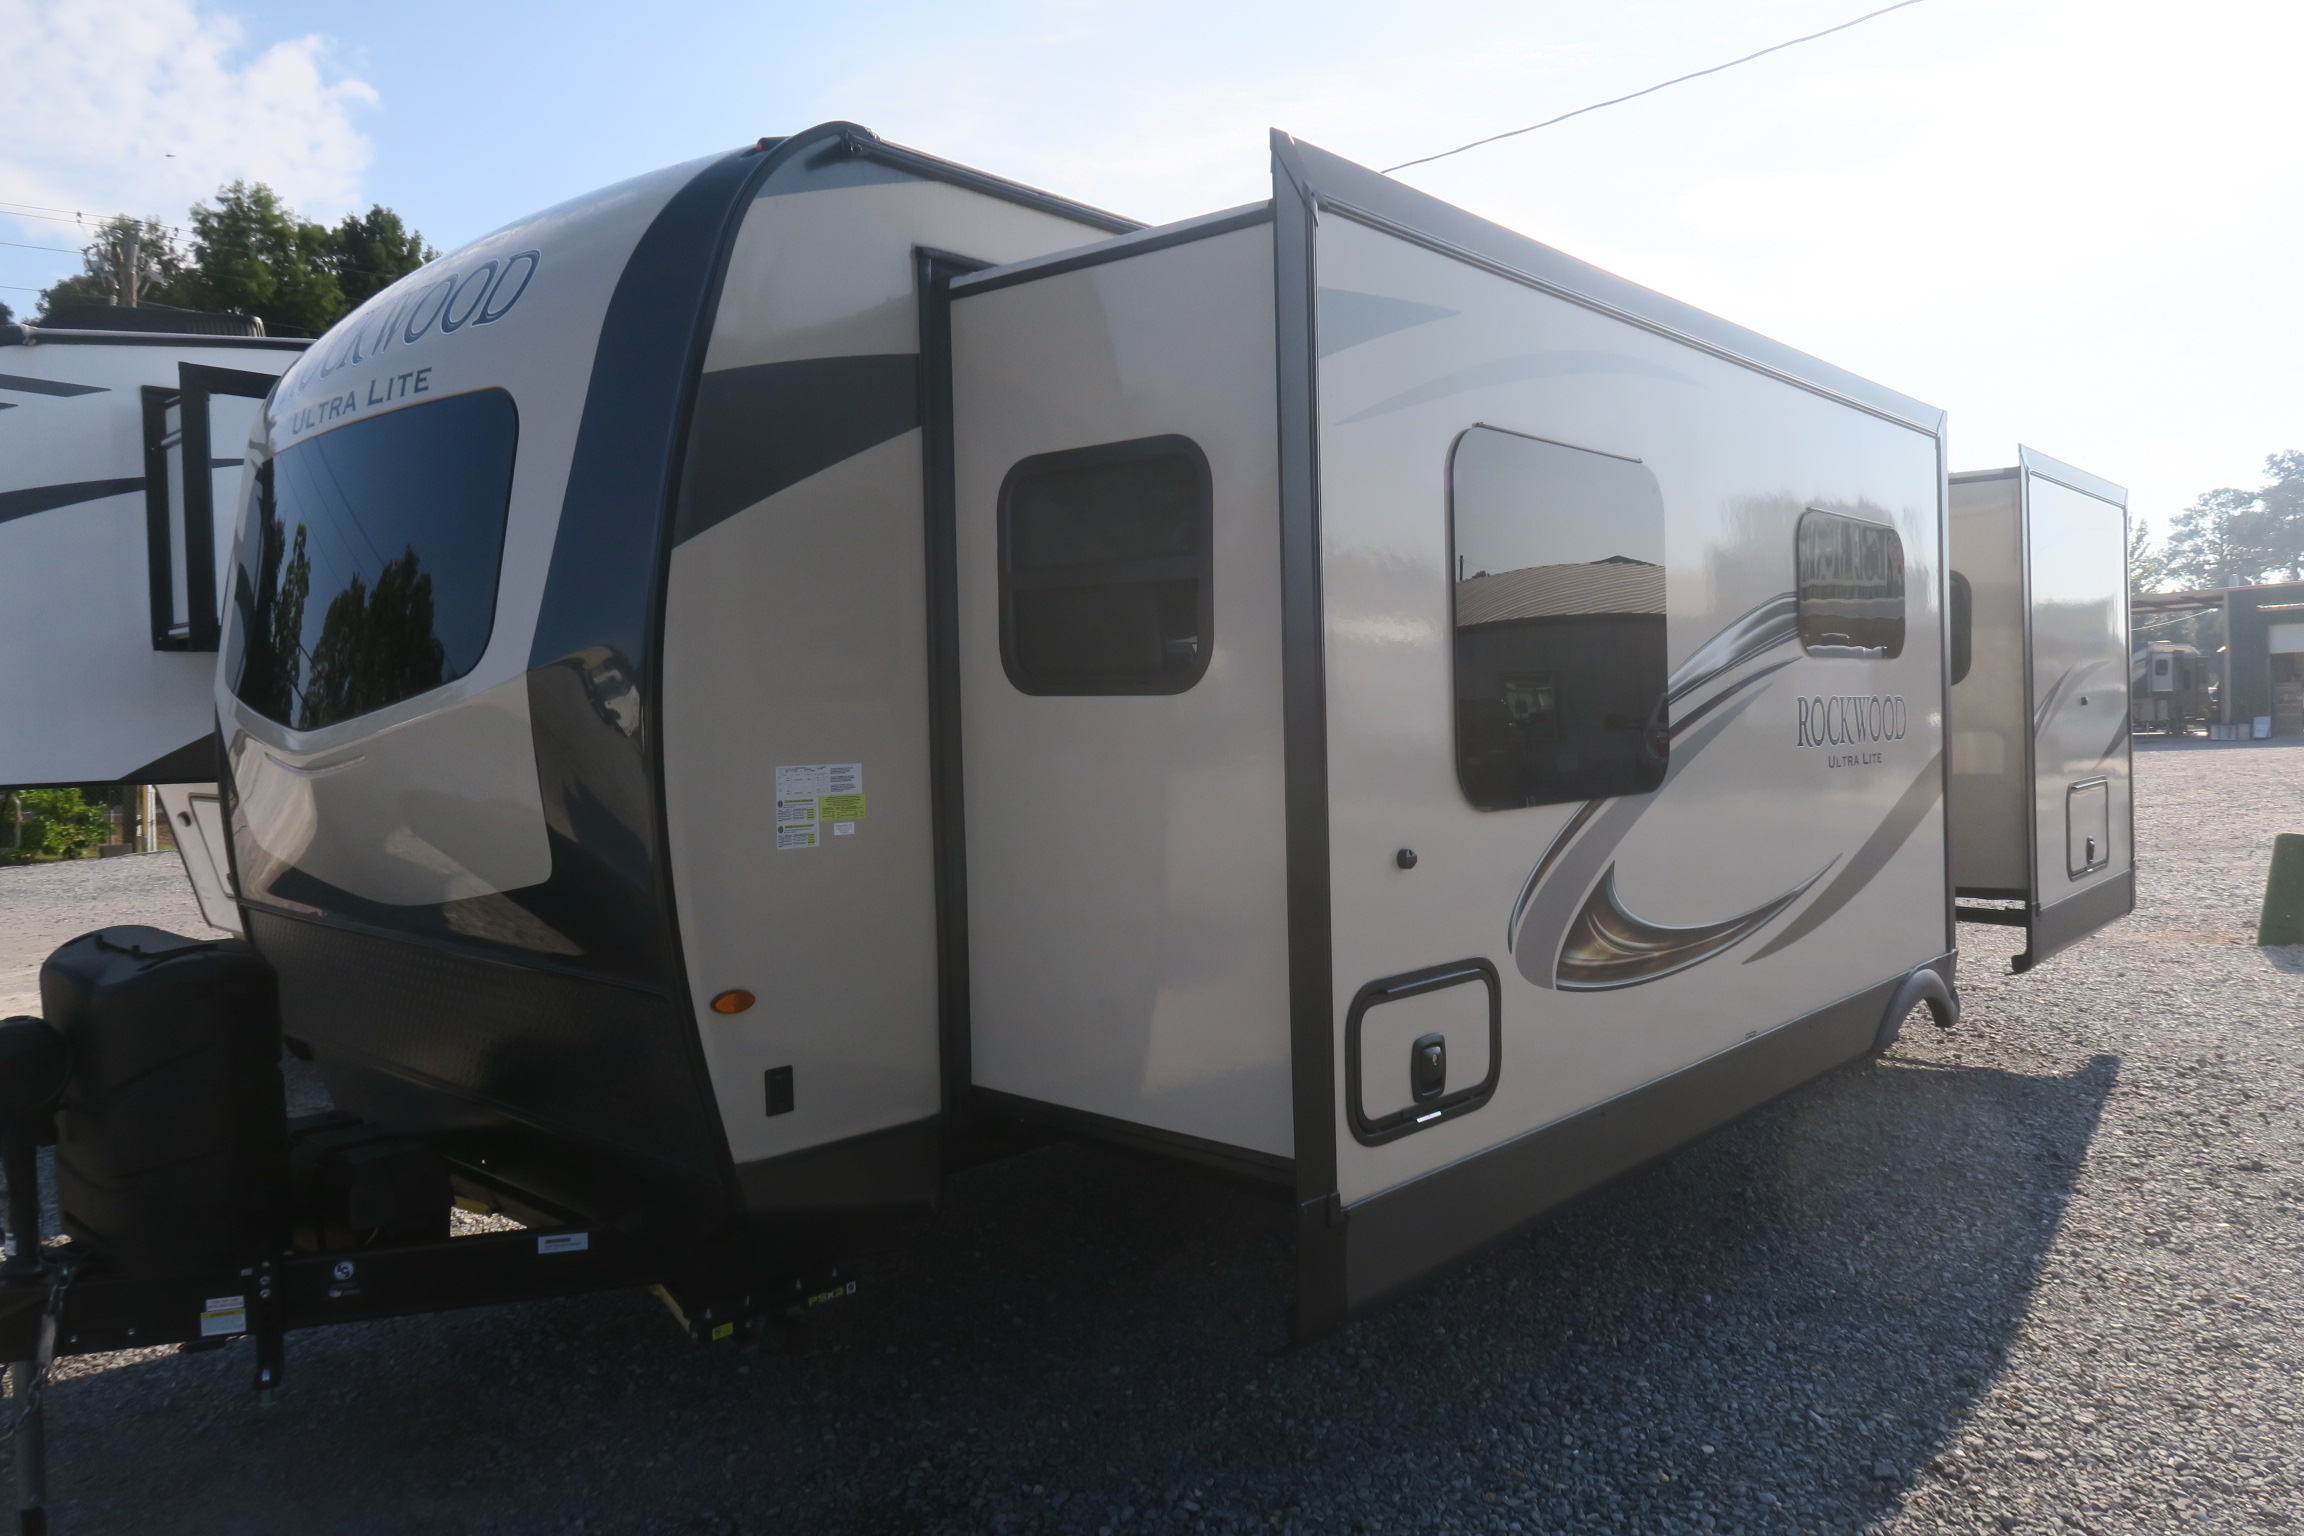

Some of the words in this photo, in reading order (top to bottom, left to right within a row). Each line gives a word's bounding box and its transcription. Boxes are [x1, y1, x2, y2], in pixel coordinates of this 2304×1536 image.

[292, 391, 357, 434] ULTRA
[367, 367, 432, 405] LITE
[1797, 695, 1907, 748] ROCKWOOD
[1828, 755, 1859, 768] ULTRA
[1863, 753, 1882, 765] LITE
